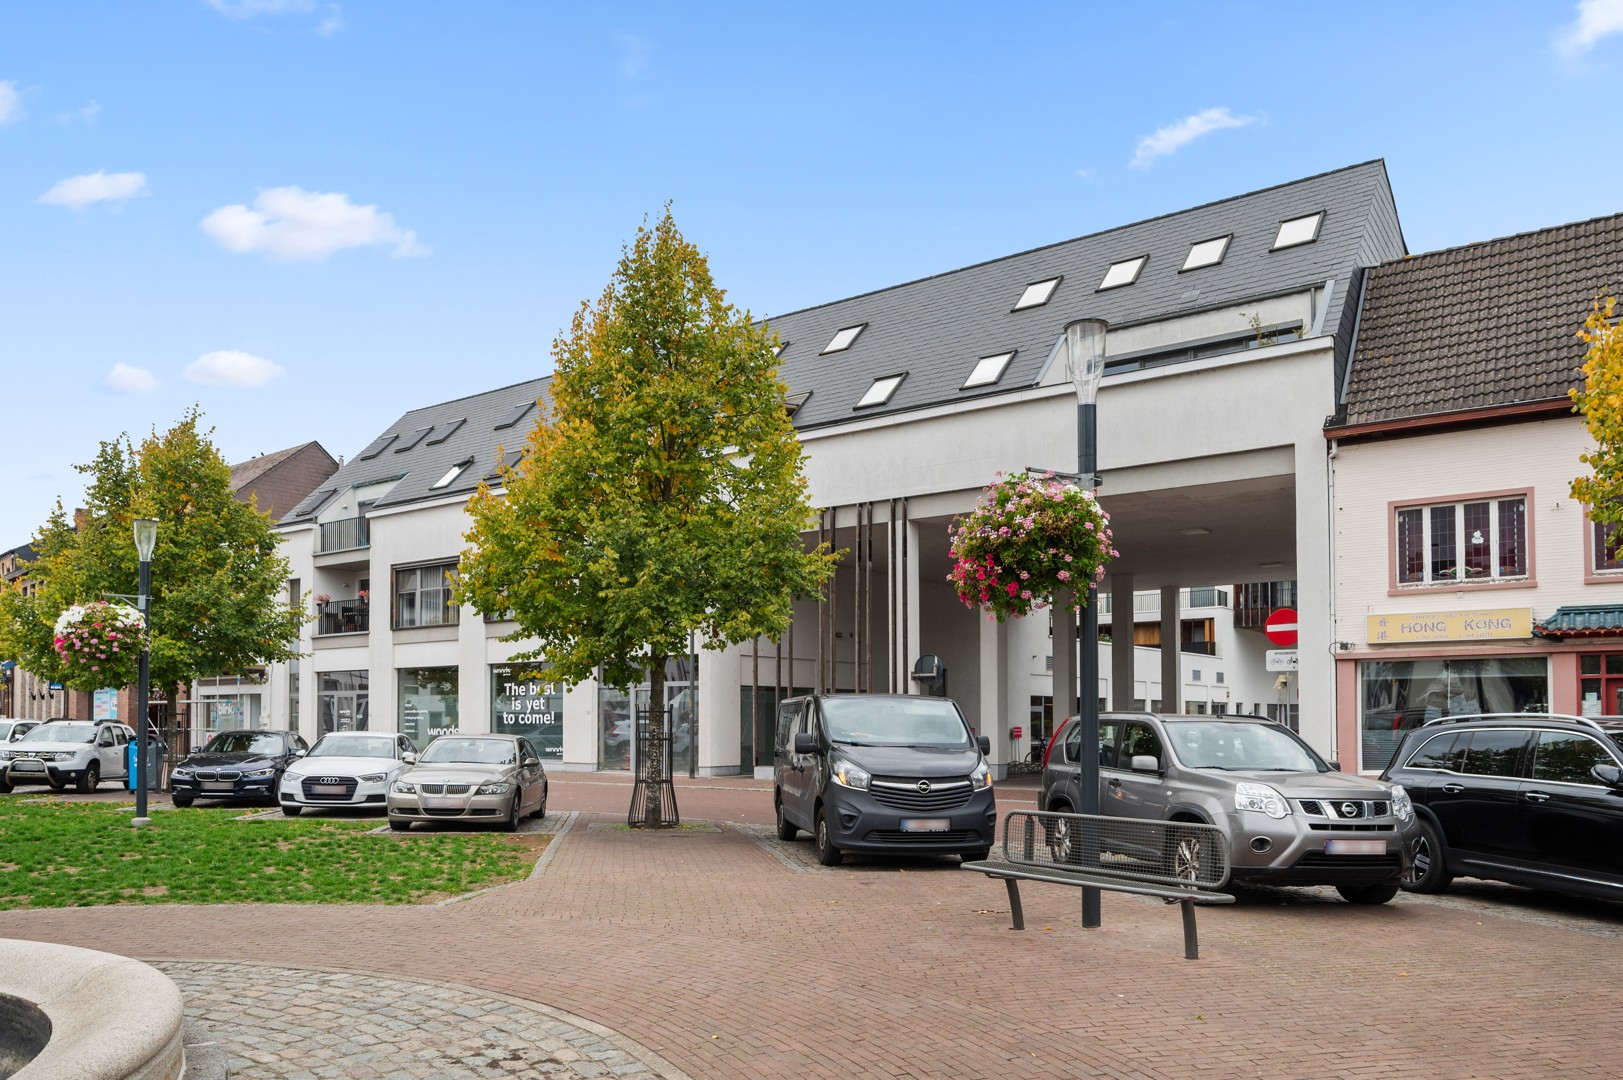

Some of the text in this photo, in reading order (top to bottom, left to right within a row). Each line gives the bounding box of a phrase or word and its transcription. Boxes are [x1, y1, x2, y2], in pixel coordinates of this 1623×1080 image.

[1401, 618, 1512, 634] HONG KONG
[503, 682, 526, 696] The
[511, 697, 545, 714] is yet
[503, 711, 555, 725] to come!
